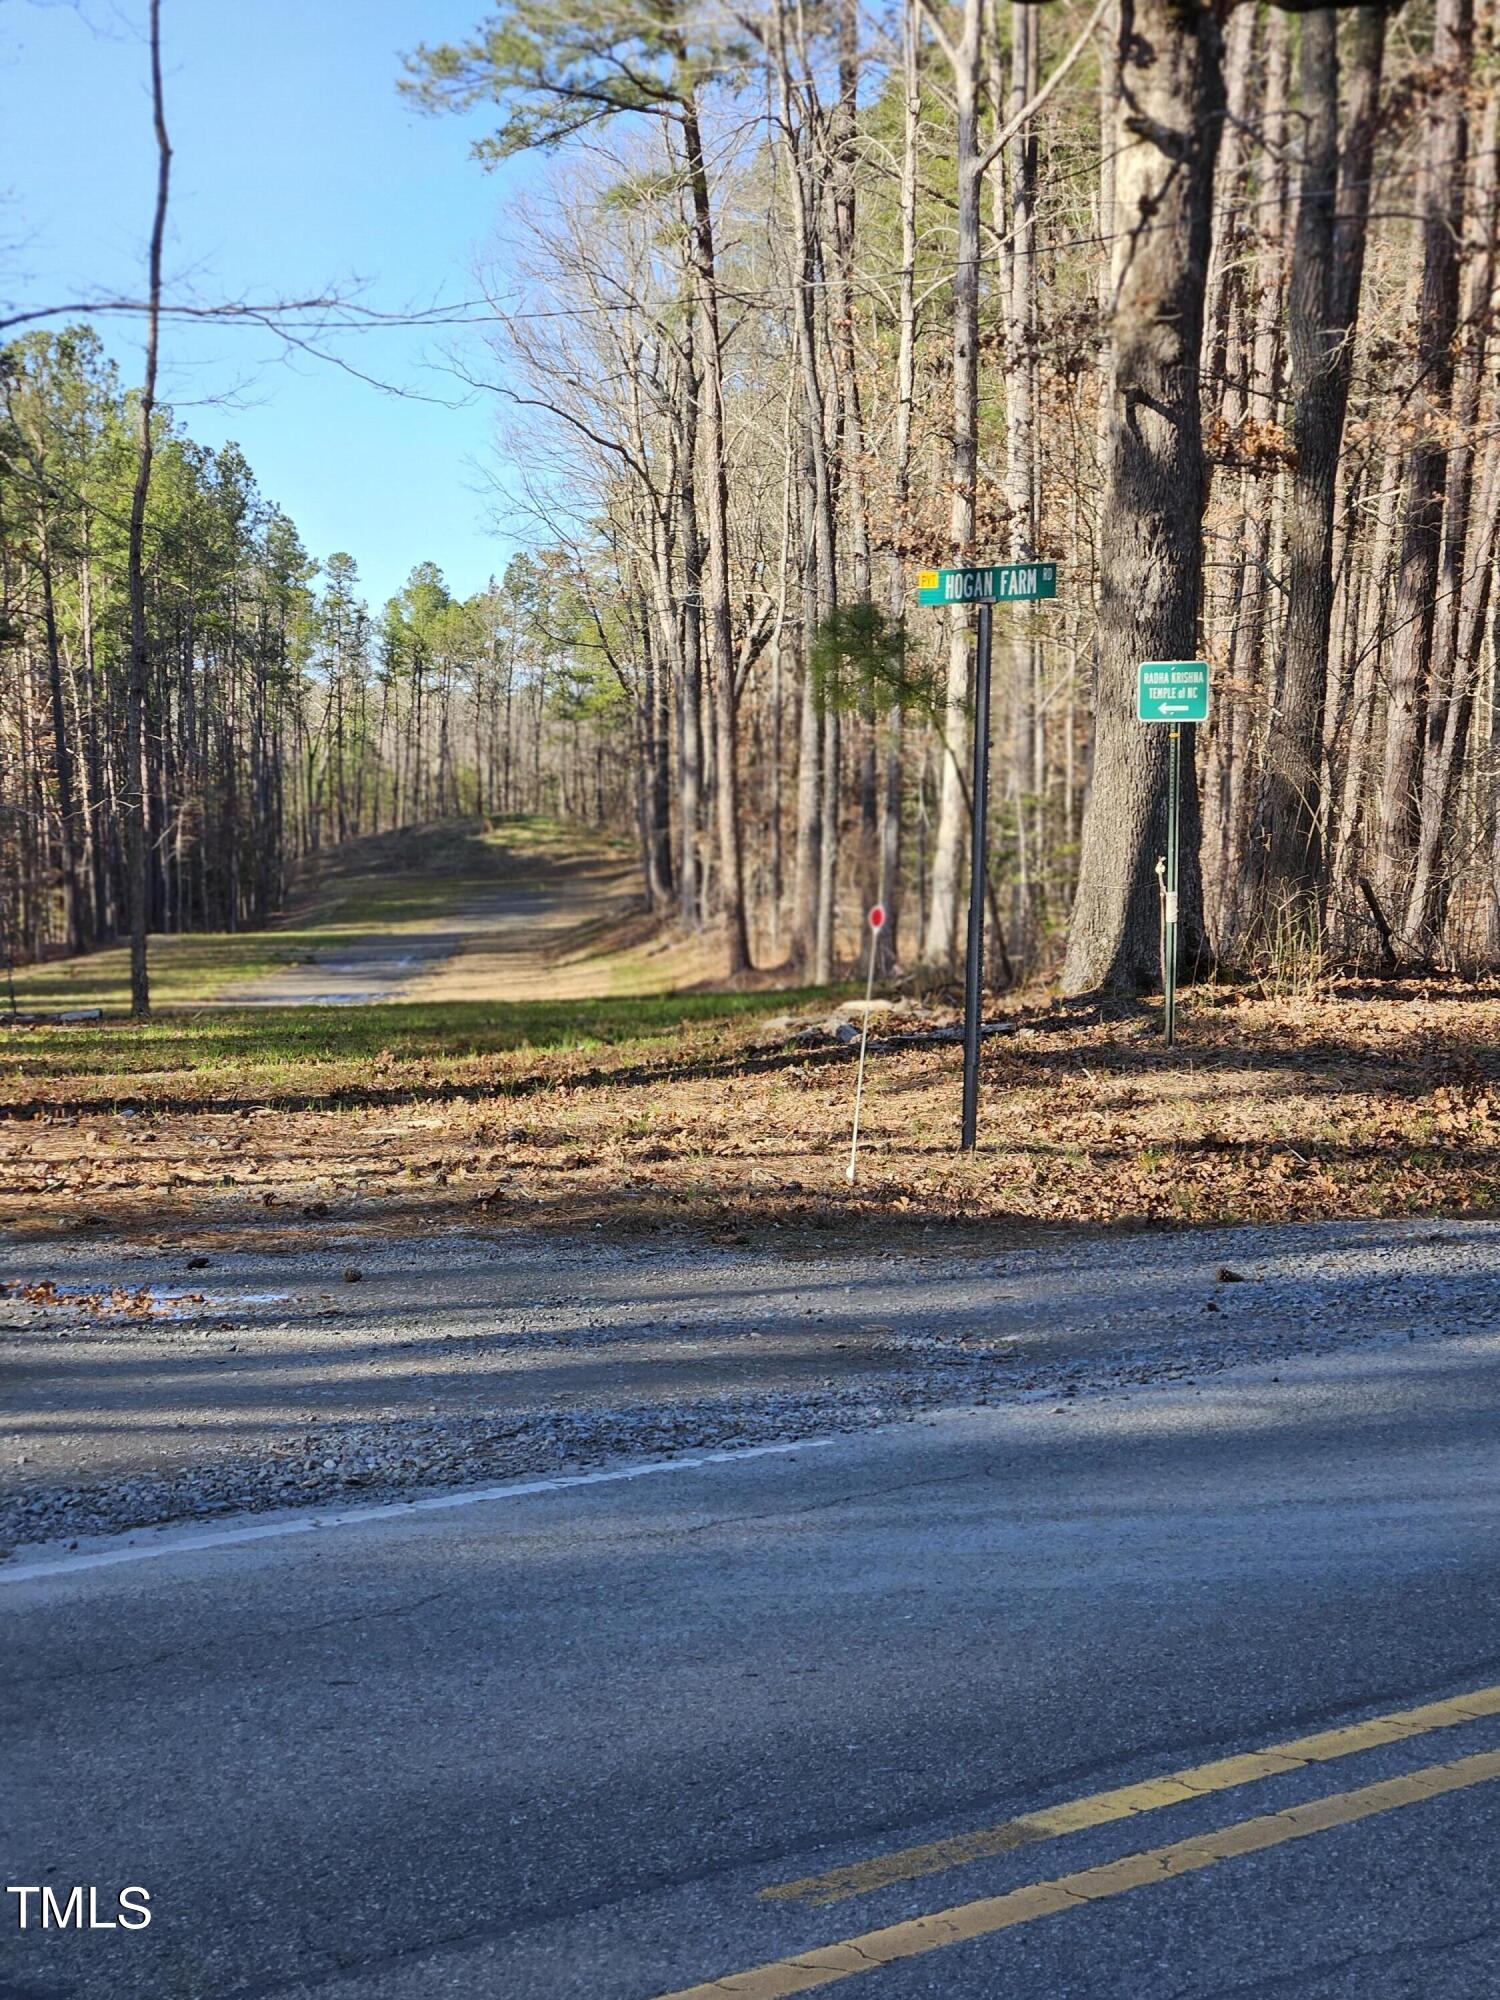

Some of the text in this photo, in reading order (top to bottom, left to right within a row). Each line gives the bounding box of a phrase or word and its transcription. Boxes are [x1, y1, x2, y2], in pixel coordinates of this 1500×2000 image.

[945, 571, 993, 600] HOGAN
[1000, 568, 1037, 596] FARM
[1042, 567, 1053, 581] RD
[1171, 671, 1204, 684] KRISHNA
[1149, 687, 1177, 699] TEMPLE
[1187, 686, 1198, 699] NC
